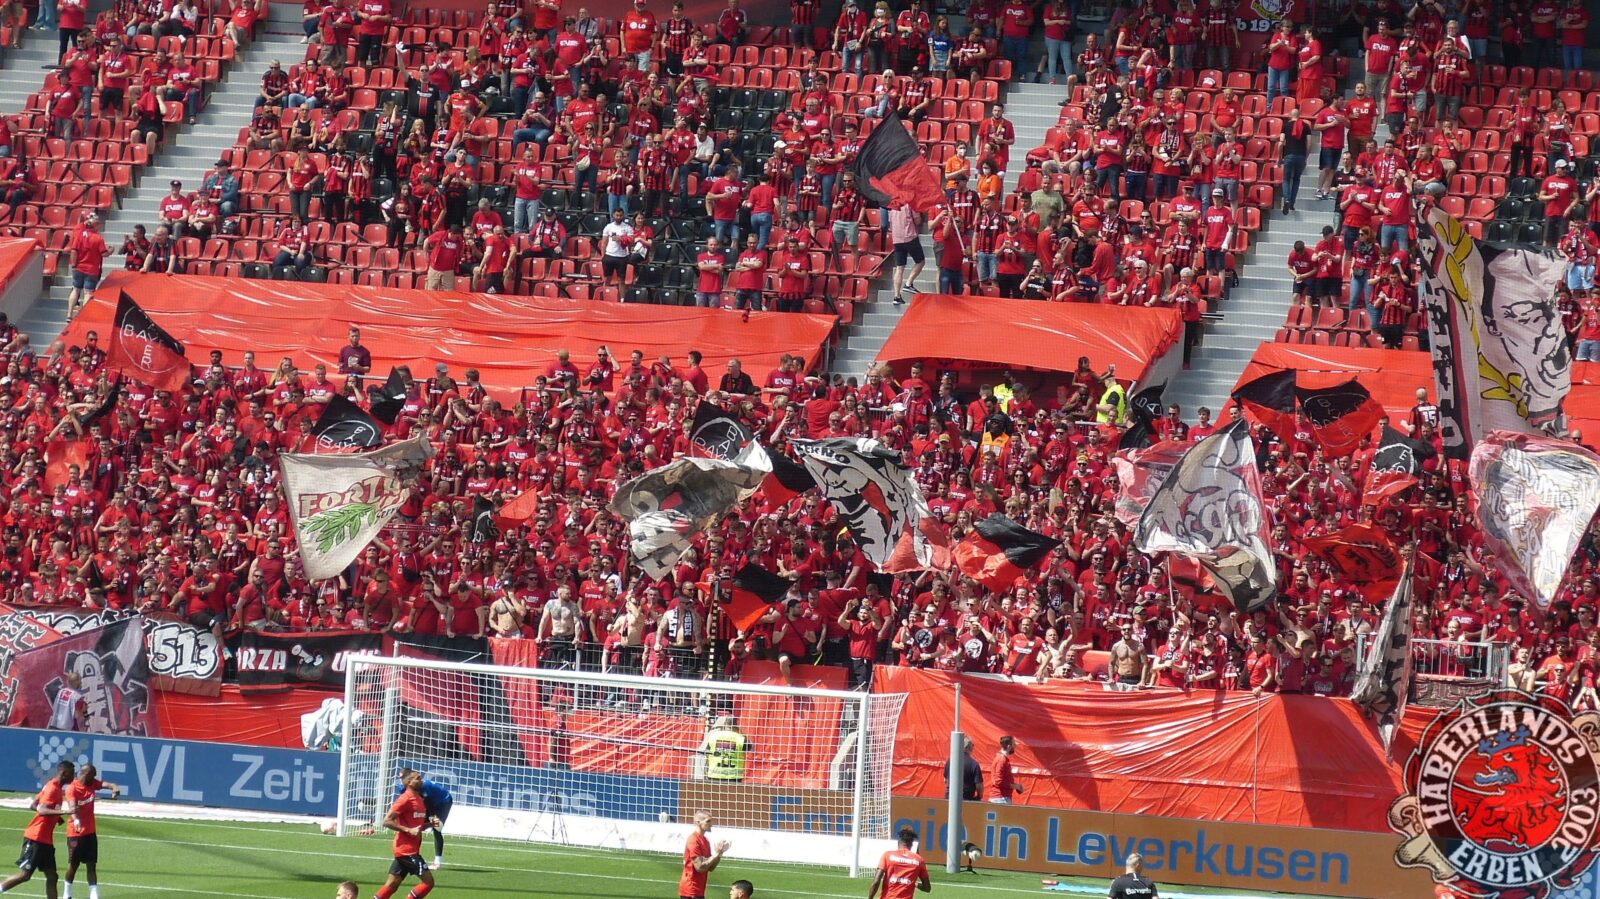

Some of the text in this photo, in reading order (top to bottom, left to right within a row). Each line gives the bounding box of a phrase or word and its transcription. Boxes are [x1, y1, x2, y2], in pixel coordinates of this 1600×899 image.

[151, 623, 218, 679] 513
[92, 740, 204, 802] EVL
[229, 753, 325, 804] Zeit
[984, 812, 1028, 860] in
[1046, 816, 1349, 884] Leverkusen
